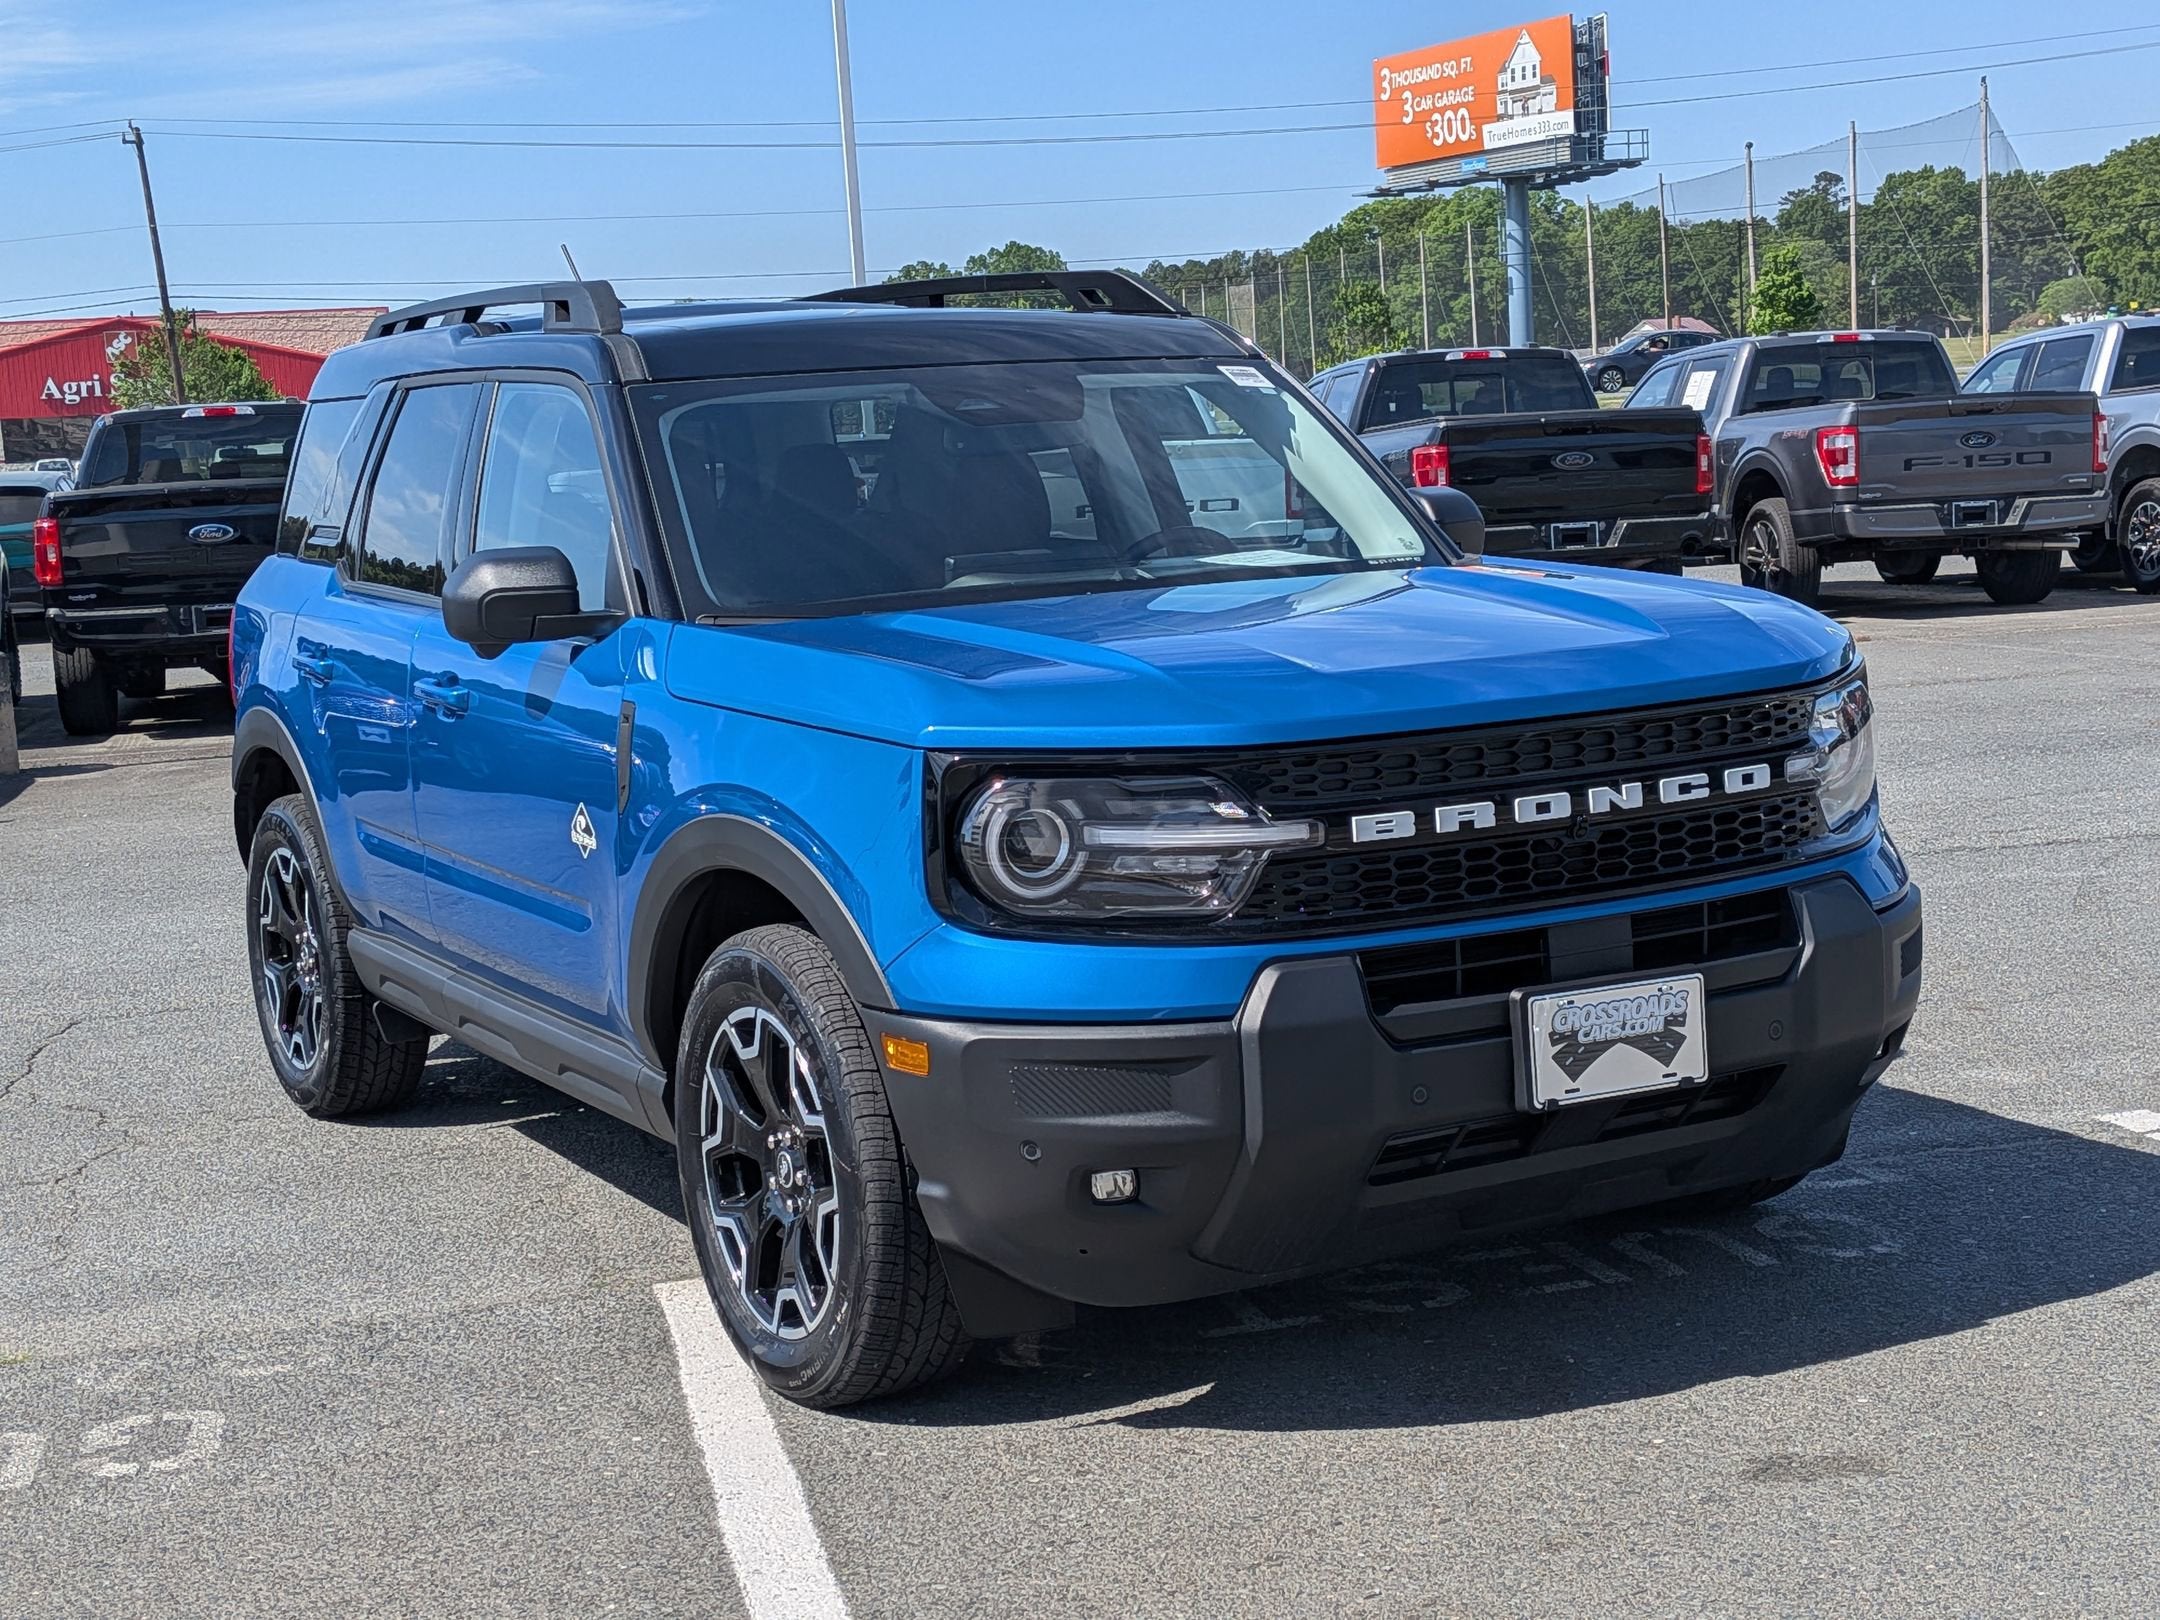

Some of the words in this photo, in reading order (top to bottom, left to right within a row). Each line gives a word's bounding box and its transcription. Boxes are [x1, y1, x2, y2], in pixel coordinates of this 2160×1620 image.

[1380, 67, 1391, 101] 3
[1391, 62, 1442, 89] THOUSAND
[1442, 59, 1459, 78] SQ.
[1460, 56, 1473, 72] FT.
[1401, 90, 1413, 124] 3
[1414, 93, 1433, 113] CAR
[1434, 86, 1475, 109] GARAGE
[1487, 119, 1570, 143] TrueHomes333.com
[40, 374, 103, 405] Agri
[1903, 451, 2052, 471] F-150
[1351, 763, 1771, 843] BRONCO
[1552, 990, 1689, 1033] CROSSROADS
[1577, 1015, 1666, 1044] CARS.COM
